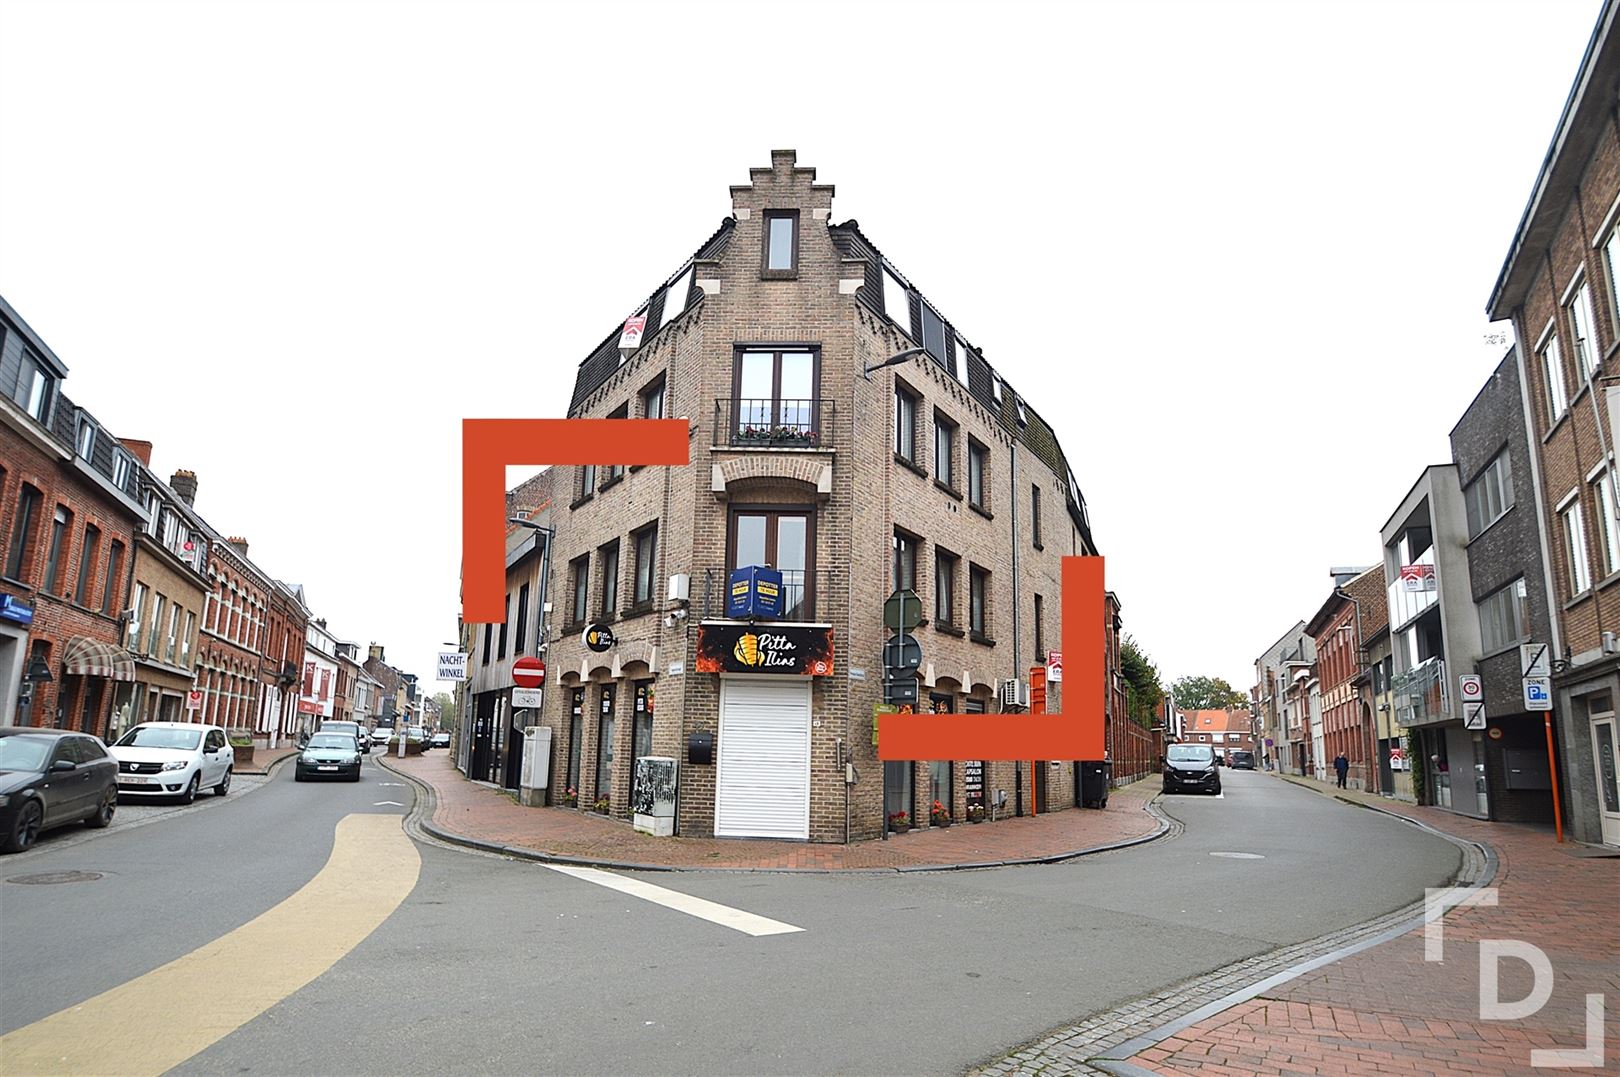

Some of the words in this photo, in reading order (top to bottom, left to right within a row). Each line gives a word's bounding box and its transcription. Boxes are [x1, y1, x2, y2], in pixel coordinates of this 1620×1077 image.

[757, 634, 797, 651] Pitta
[439, 655, 465, 666] NACHT-
[764, 651, 796, 667] Ilias
[439, 668, 465, 678] WINKEL
